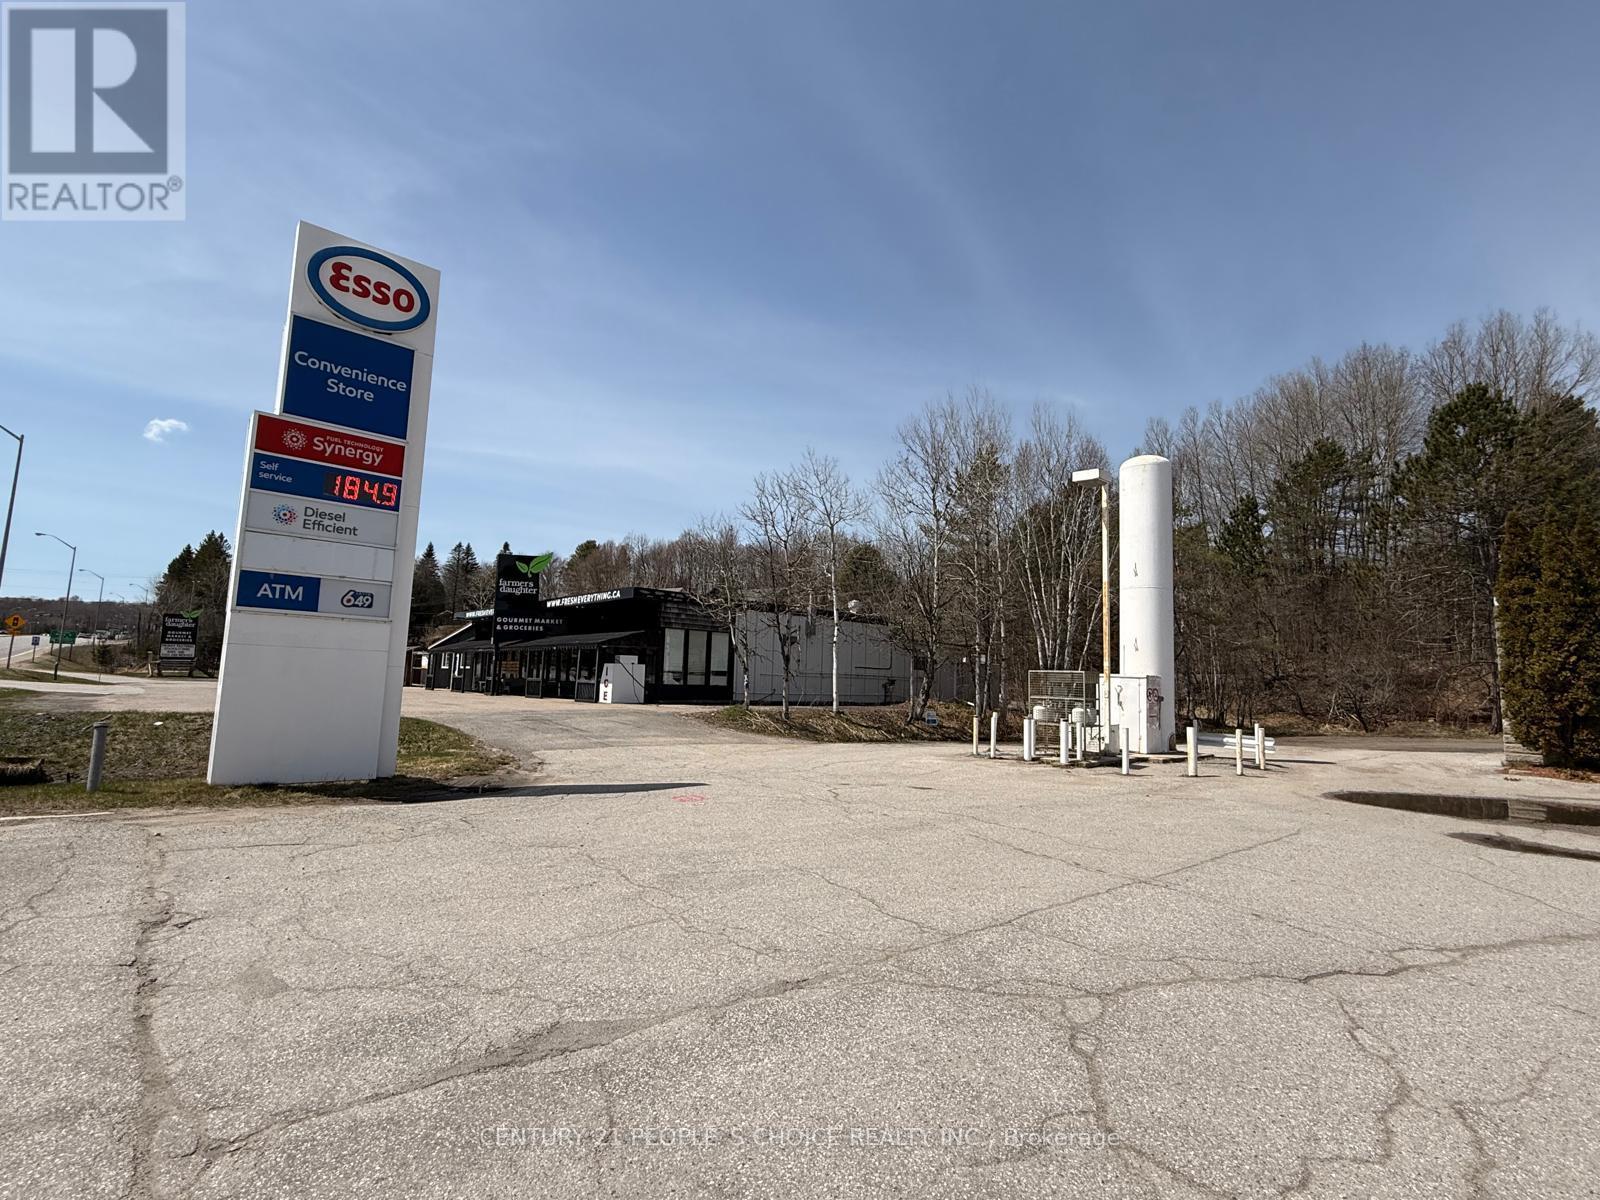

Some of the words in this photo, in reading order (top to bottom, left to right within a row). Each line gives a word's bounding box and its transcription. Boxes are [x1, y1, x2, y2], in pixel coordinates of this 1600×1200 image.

[294, 350, 407, 392] Convenience
[326, 378, 374, 402] Store
[312, 436, 384, 466] Synergy
[326, 435, 342, 443] FUEL
[343, 439, 384, 452] TECHNOLOGY
[259, 460, 279, 471] Self
[258, 471, 293, 483] service
[304, 506, 346, 522] Diesel
[302, 519, 358, 536] Efficient
[256, 583, 303, 601] ATM
[500, 585, 538, 595] daughter
[546, 590, 621, 608] WWW.FRESHEVERYTHING.CA
